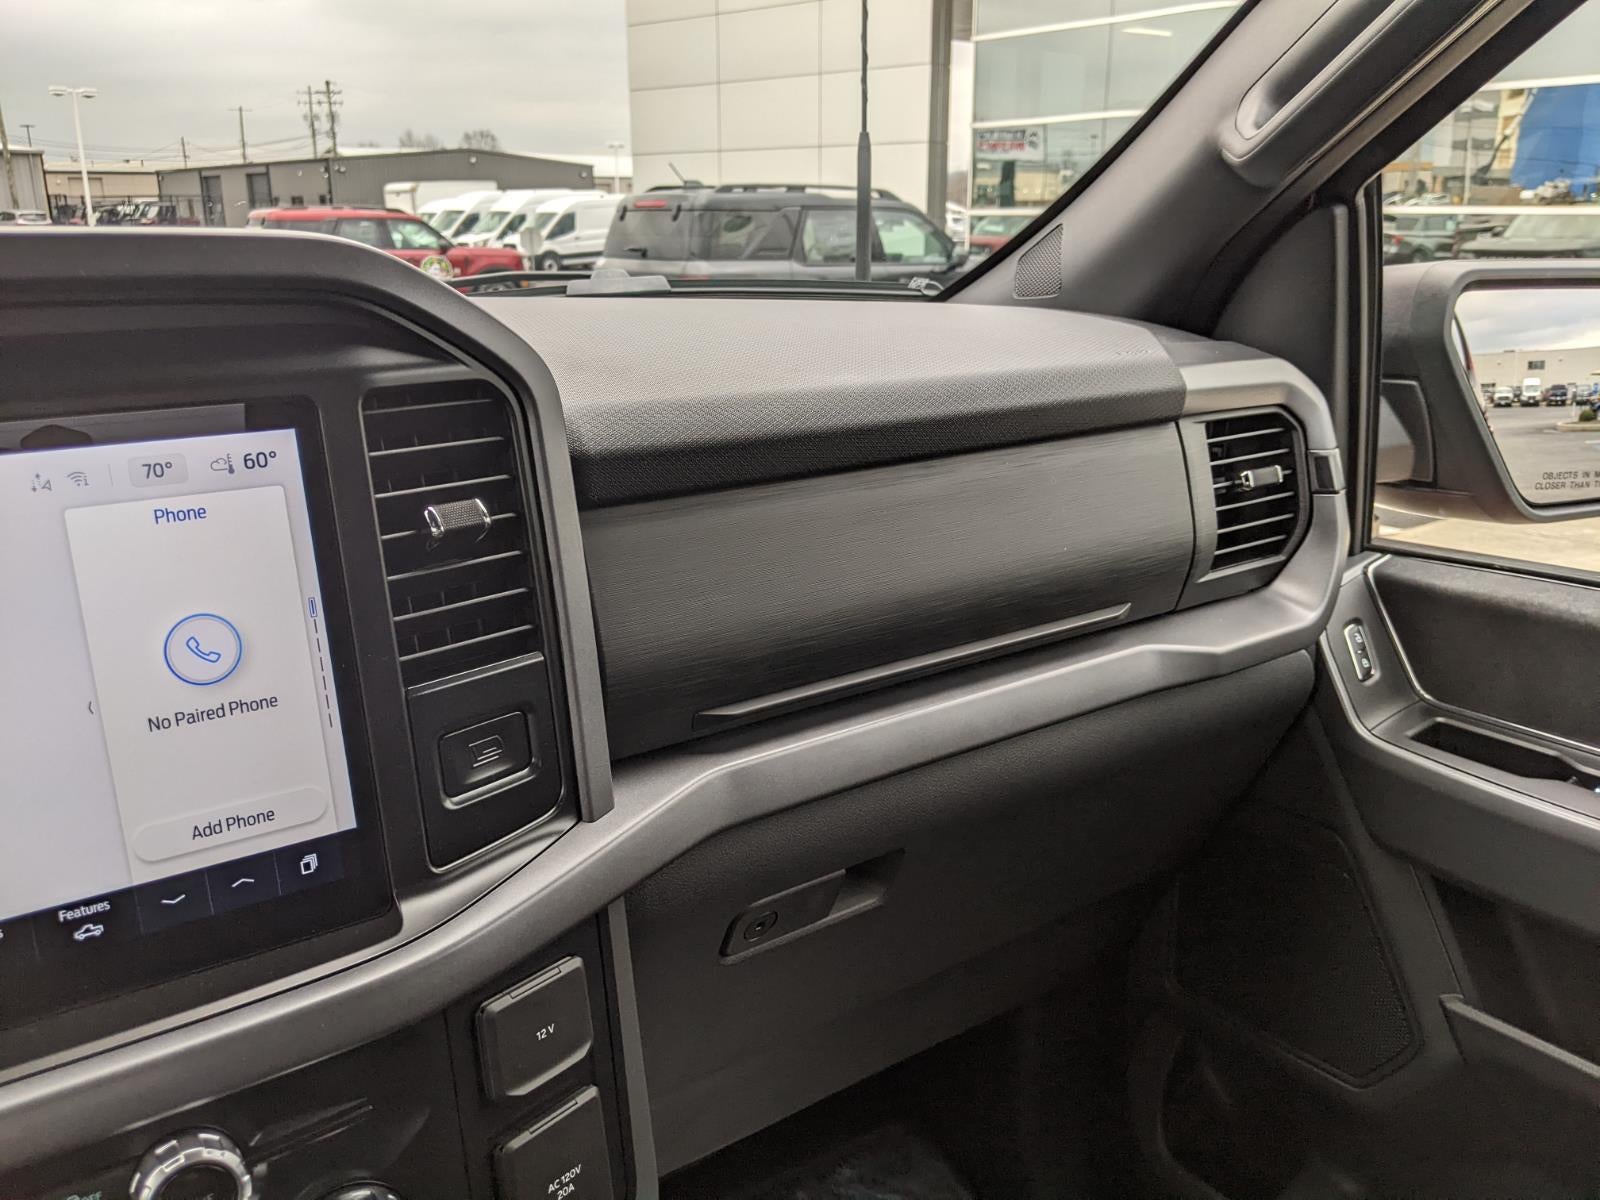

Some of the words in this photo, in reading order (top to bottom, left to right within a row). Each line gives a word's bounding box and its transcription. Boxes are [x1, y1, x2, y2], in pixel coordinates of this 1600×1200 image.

[142, 461, 173, 479] 70°
[243, 450, 277, 470] 60°
[1535, 481, 1567, 490] CLOSER
[1570, 480, 1590, 489] THAN
[1542, 471, 1579, 480] OBJECTS
[154, 505, 207, 525] Phone
[147, 715, 172, 732] No
[174, 703, 226, 727] Paired
[228, 696, 279, 716] Phone
[191, 819, 223, 840] Add
[225, 809, 276, 832] Phone
[58, 900, 111, 922] Features
[548, 1178, 561, 1194] AC
[561, 1163, 582, 1184] 120V
[556, 1182, 575, 1200] 20A
